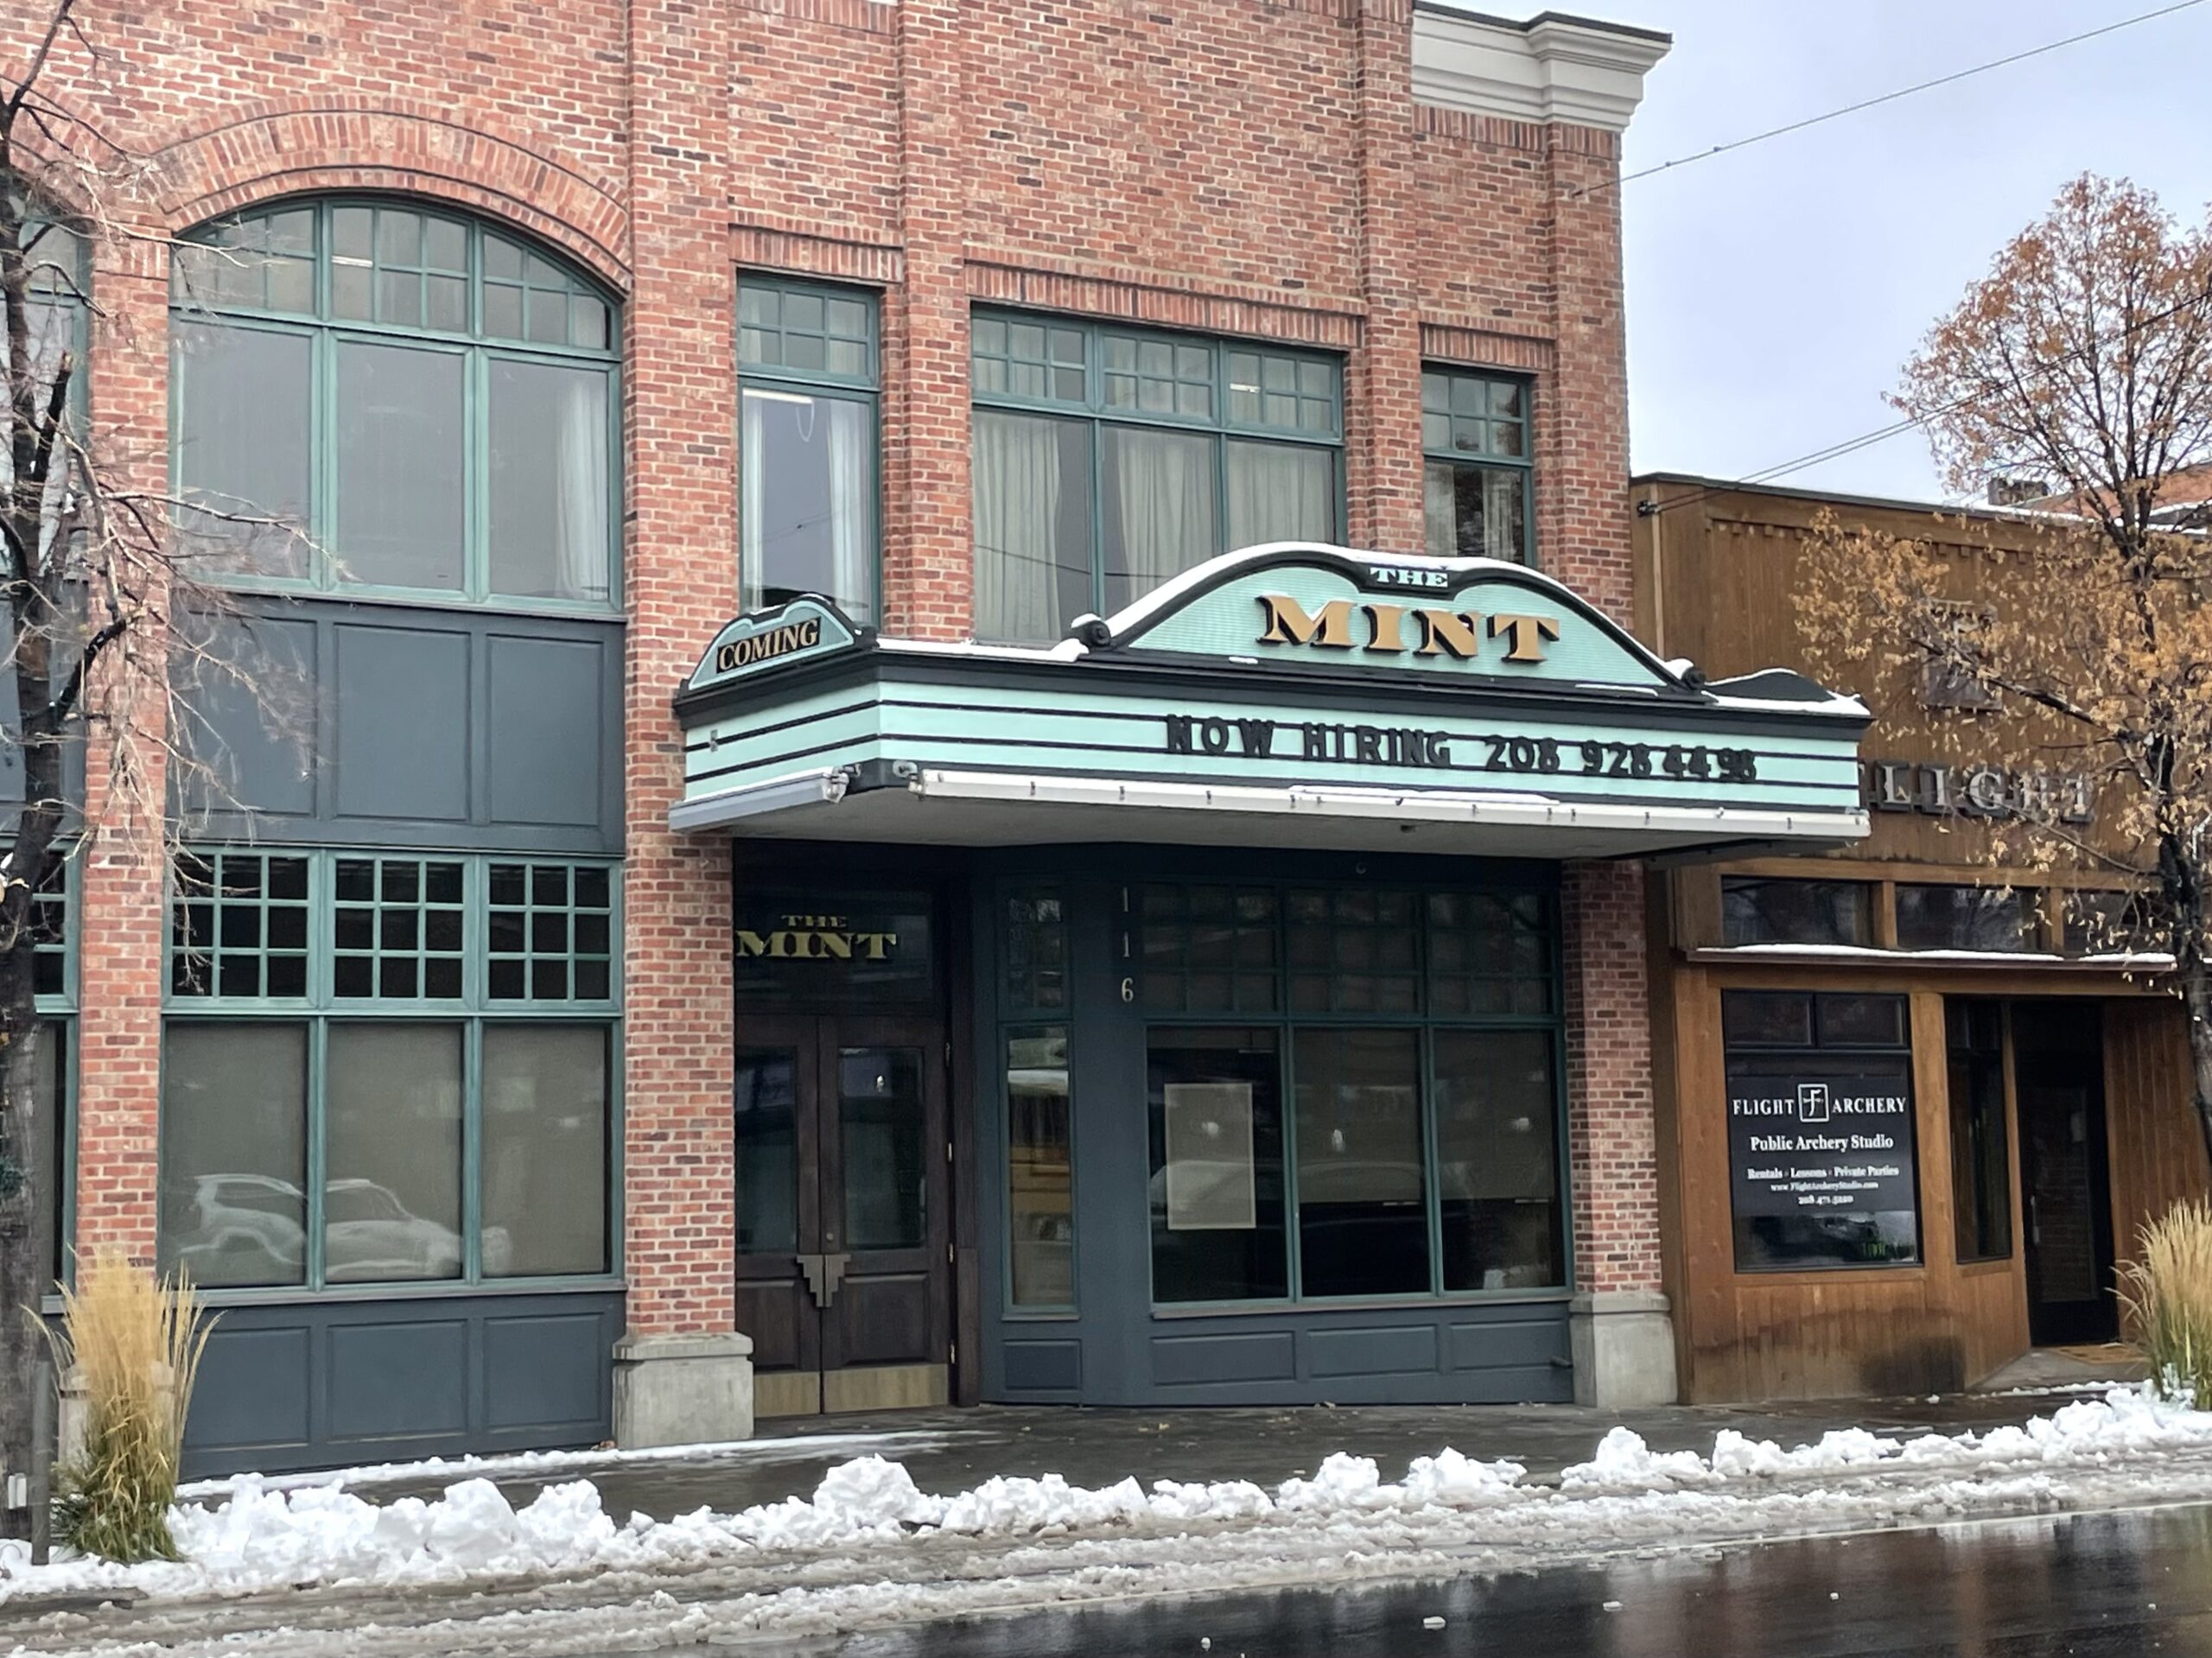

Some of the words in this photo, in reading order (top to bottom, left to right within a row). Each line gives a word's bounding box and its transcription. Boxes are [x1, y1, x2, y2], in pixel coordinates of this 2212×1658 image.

[1370, 567, 1449, 588] THE
[1255, 594, 1560, 664] MINT
[719, 618, 818, 671] COMING
[1166, 713, 1275, 759] NOW
[1302, 721, 1451, 767] HIRING
[1481, 734, 1560, 773] 208
[1580, 740, 1652, 779] 928
[1662, 744, 1758, 783] 4498
[1858, 761, 2094, 821] LIGHT
[780, 914, 849, 928] THE
[734, 930, 897, 960] MINT
[1732, 1098, 1795, 1115] FLIGHT
[1831, 1096, 1907, 1114] ARCHERY
[1750, 1135, 1794, 1152] Public
[1796, 1134, 1848, 1153] Archery
[1851, 1133, 1895, 1150] Studio
[1747, 1167, 1783, 1180] Rentals
[1790, 1166, 1827, 1178] Lessons
[1834, 1166, 1867, 1178] Private
[1867, 1164, 1900, 1177] Parties
